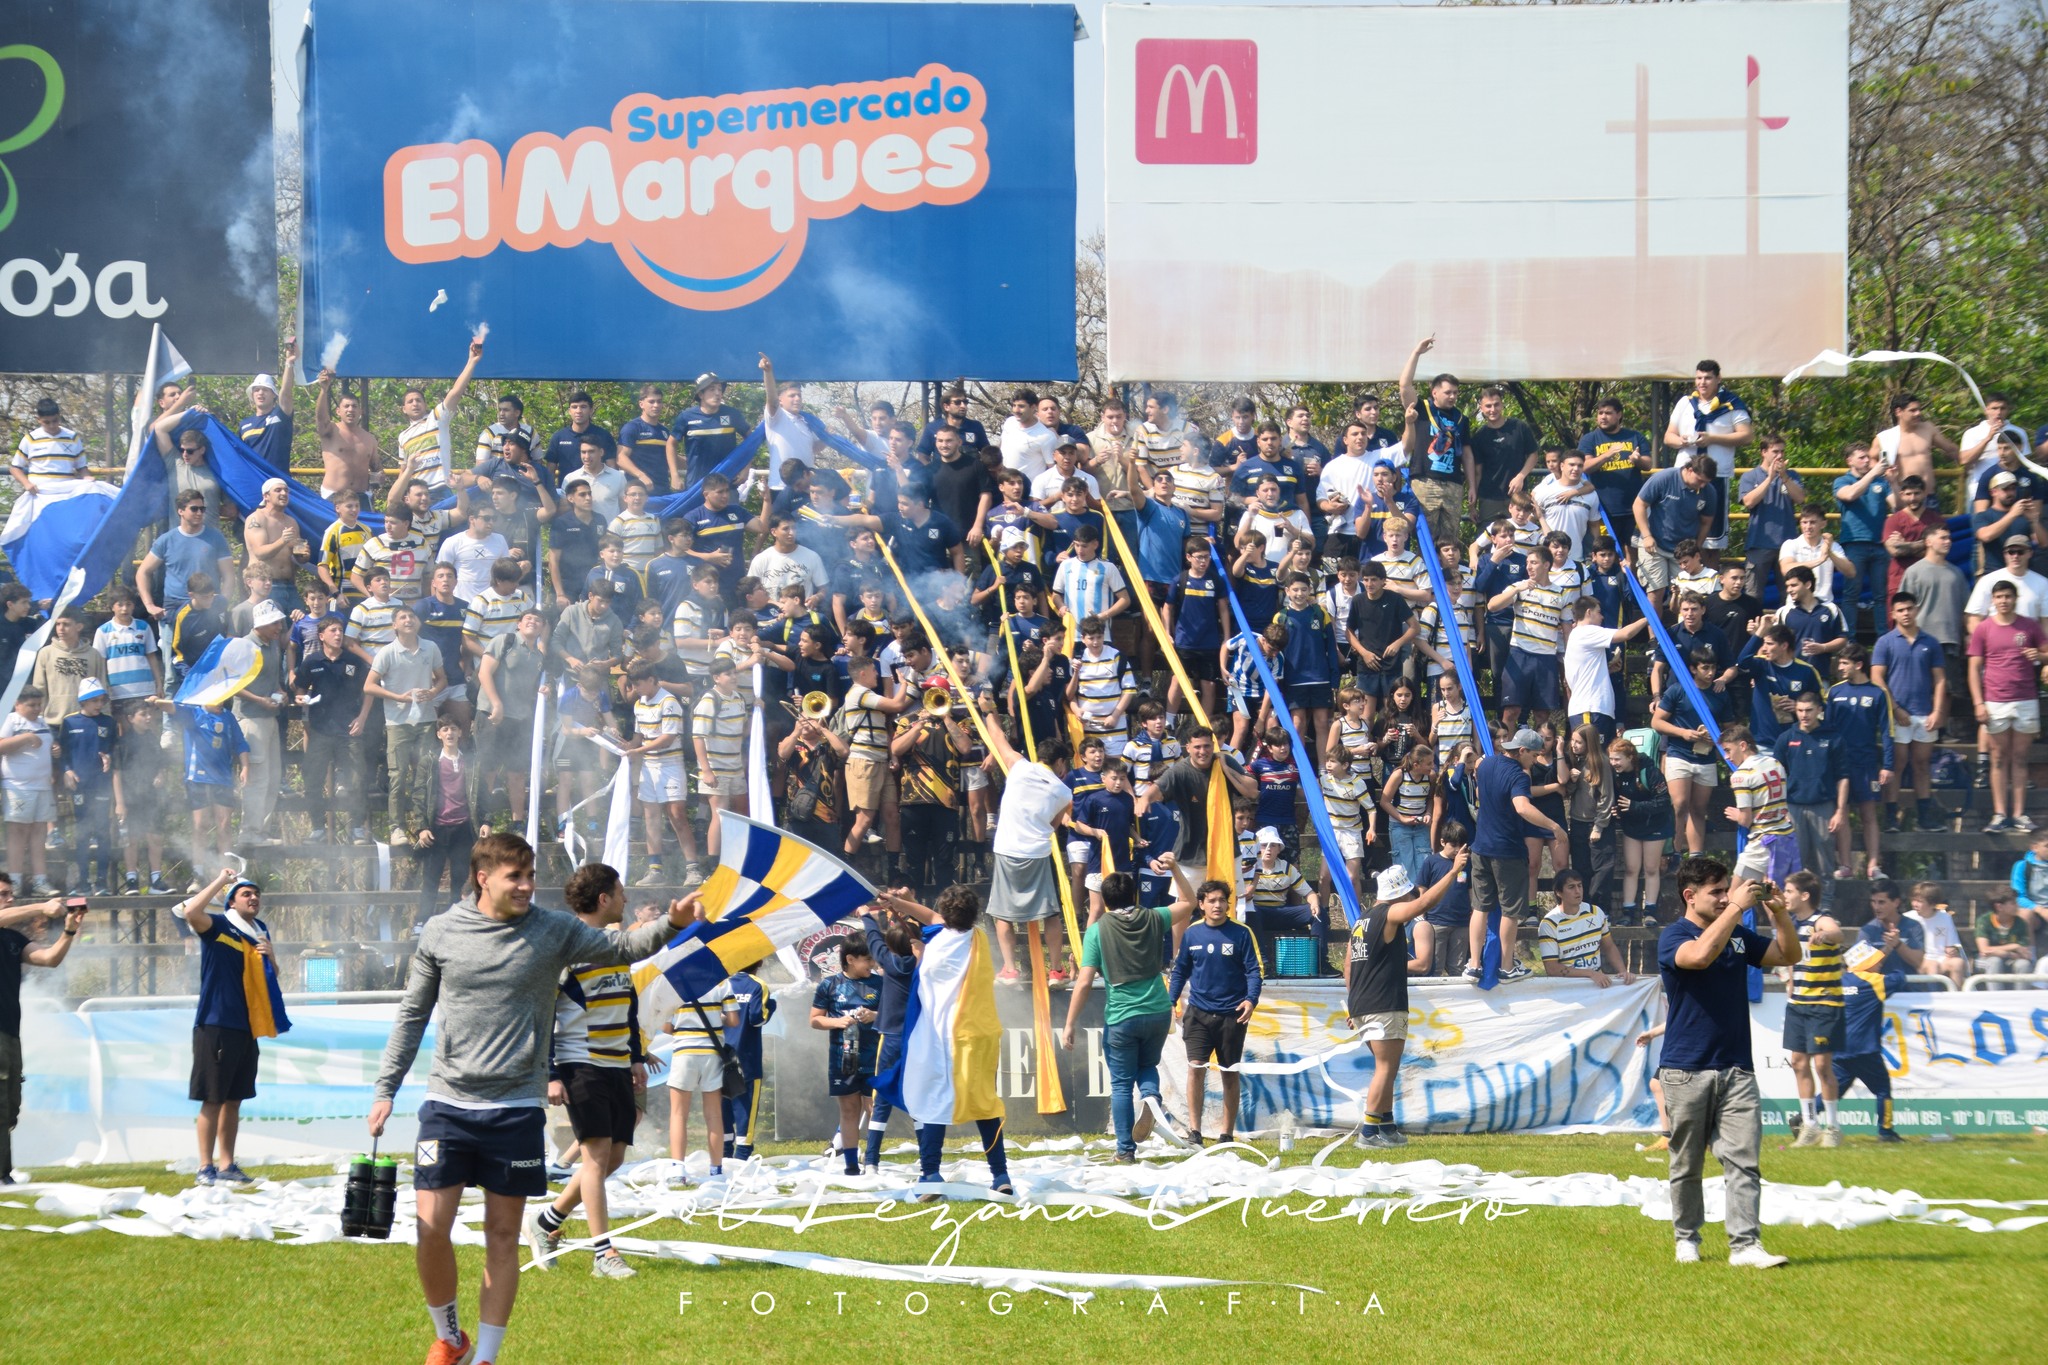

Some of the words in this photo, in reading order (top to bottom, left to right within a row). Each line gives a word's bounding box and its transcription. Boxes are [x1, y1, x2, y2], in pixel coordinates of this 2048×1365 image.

[627, 76, 971, 149] Supermercado
[402, 153, 489, 247] El
[516, 126, 978, 233] Marques
[391, 550, 415, 576] 19
[1076, 578, 1087, 591] 10
[117, 645, 140, 655] VISA
[1762, 769, 1783, 800] 13
[1761, 1111, 1782, 1125] ERA
[1920, 1110, 1942, 1126] 851
